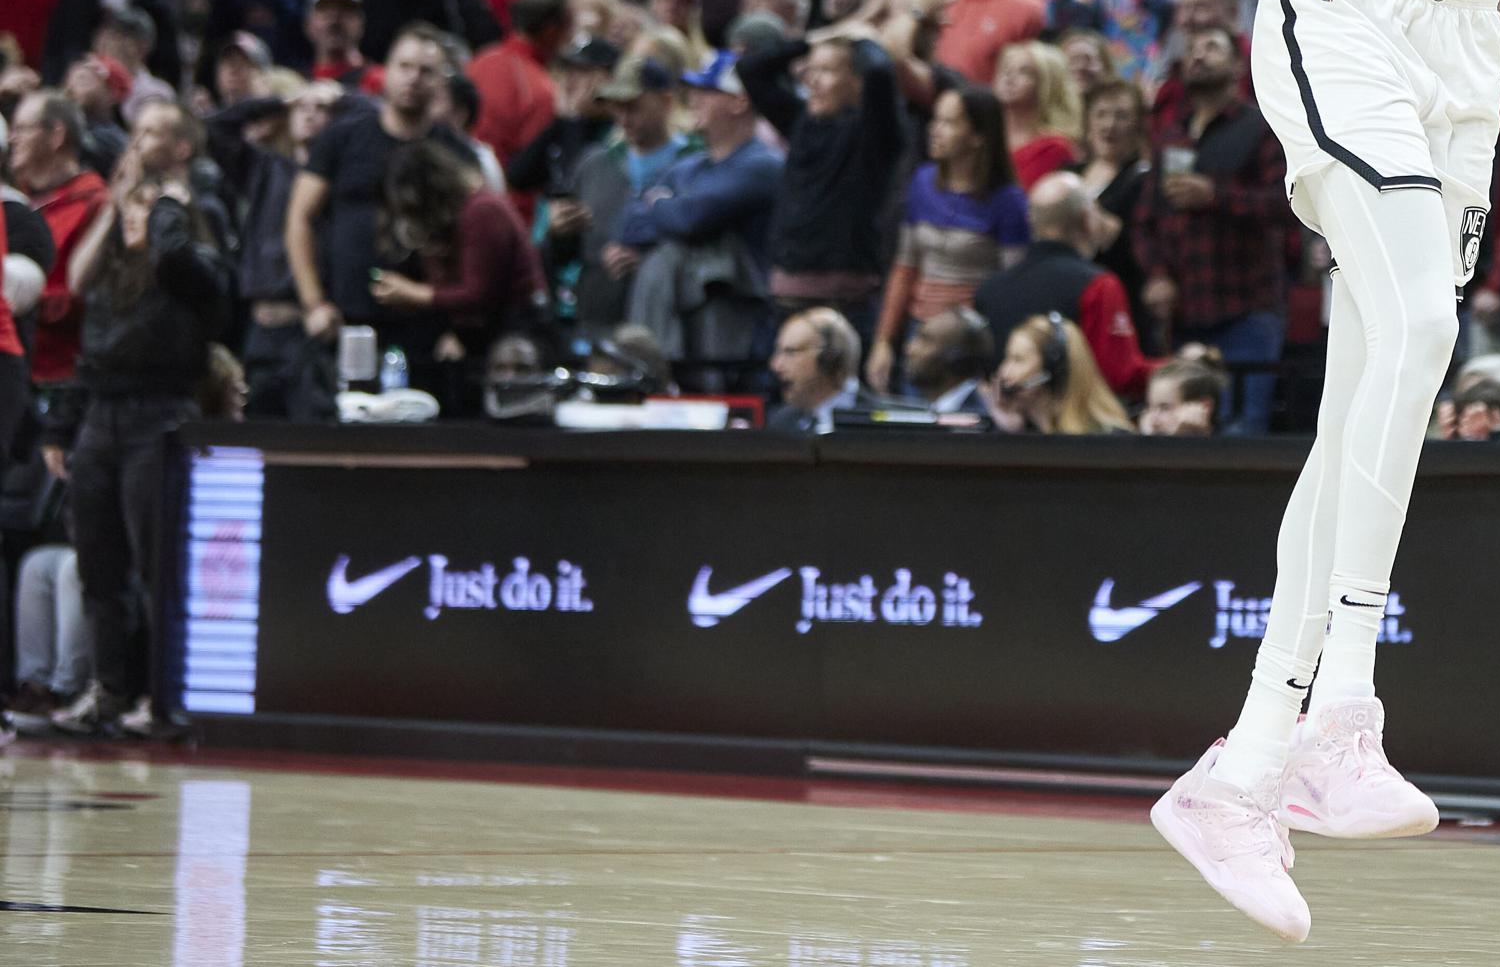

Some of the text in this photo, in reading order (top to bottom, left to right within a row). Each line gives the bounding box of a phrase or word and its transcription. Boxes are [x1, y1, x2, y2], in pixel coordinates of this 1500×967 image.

[424, 554, 593, 620] Just do it.
[796, 566, 983, 633] Just do it.
[1209, 580, 1273, 649] Jus
